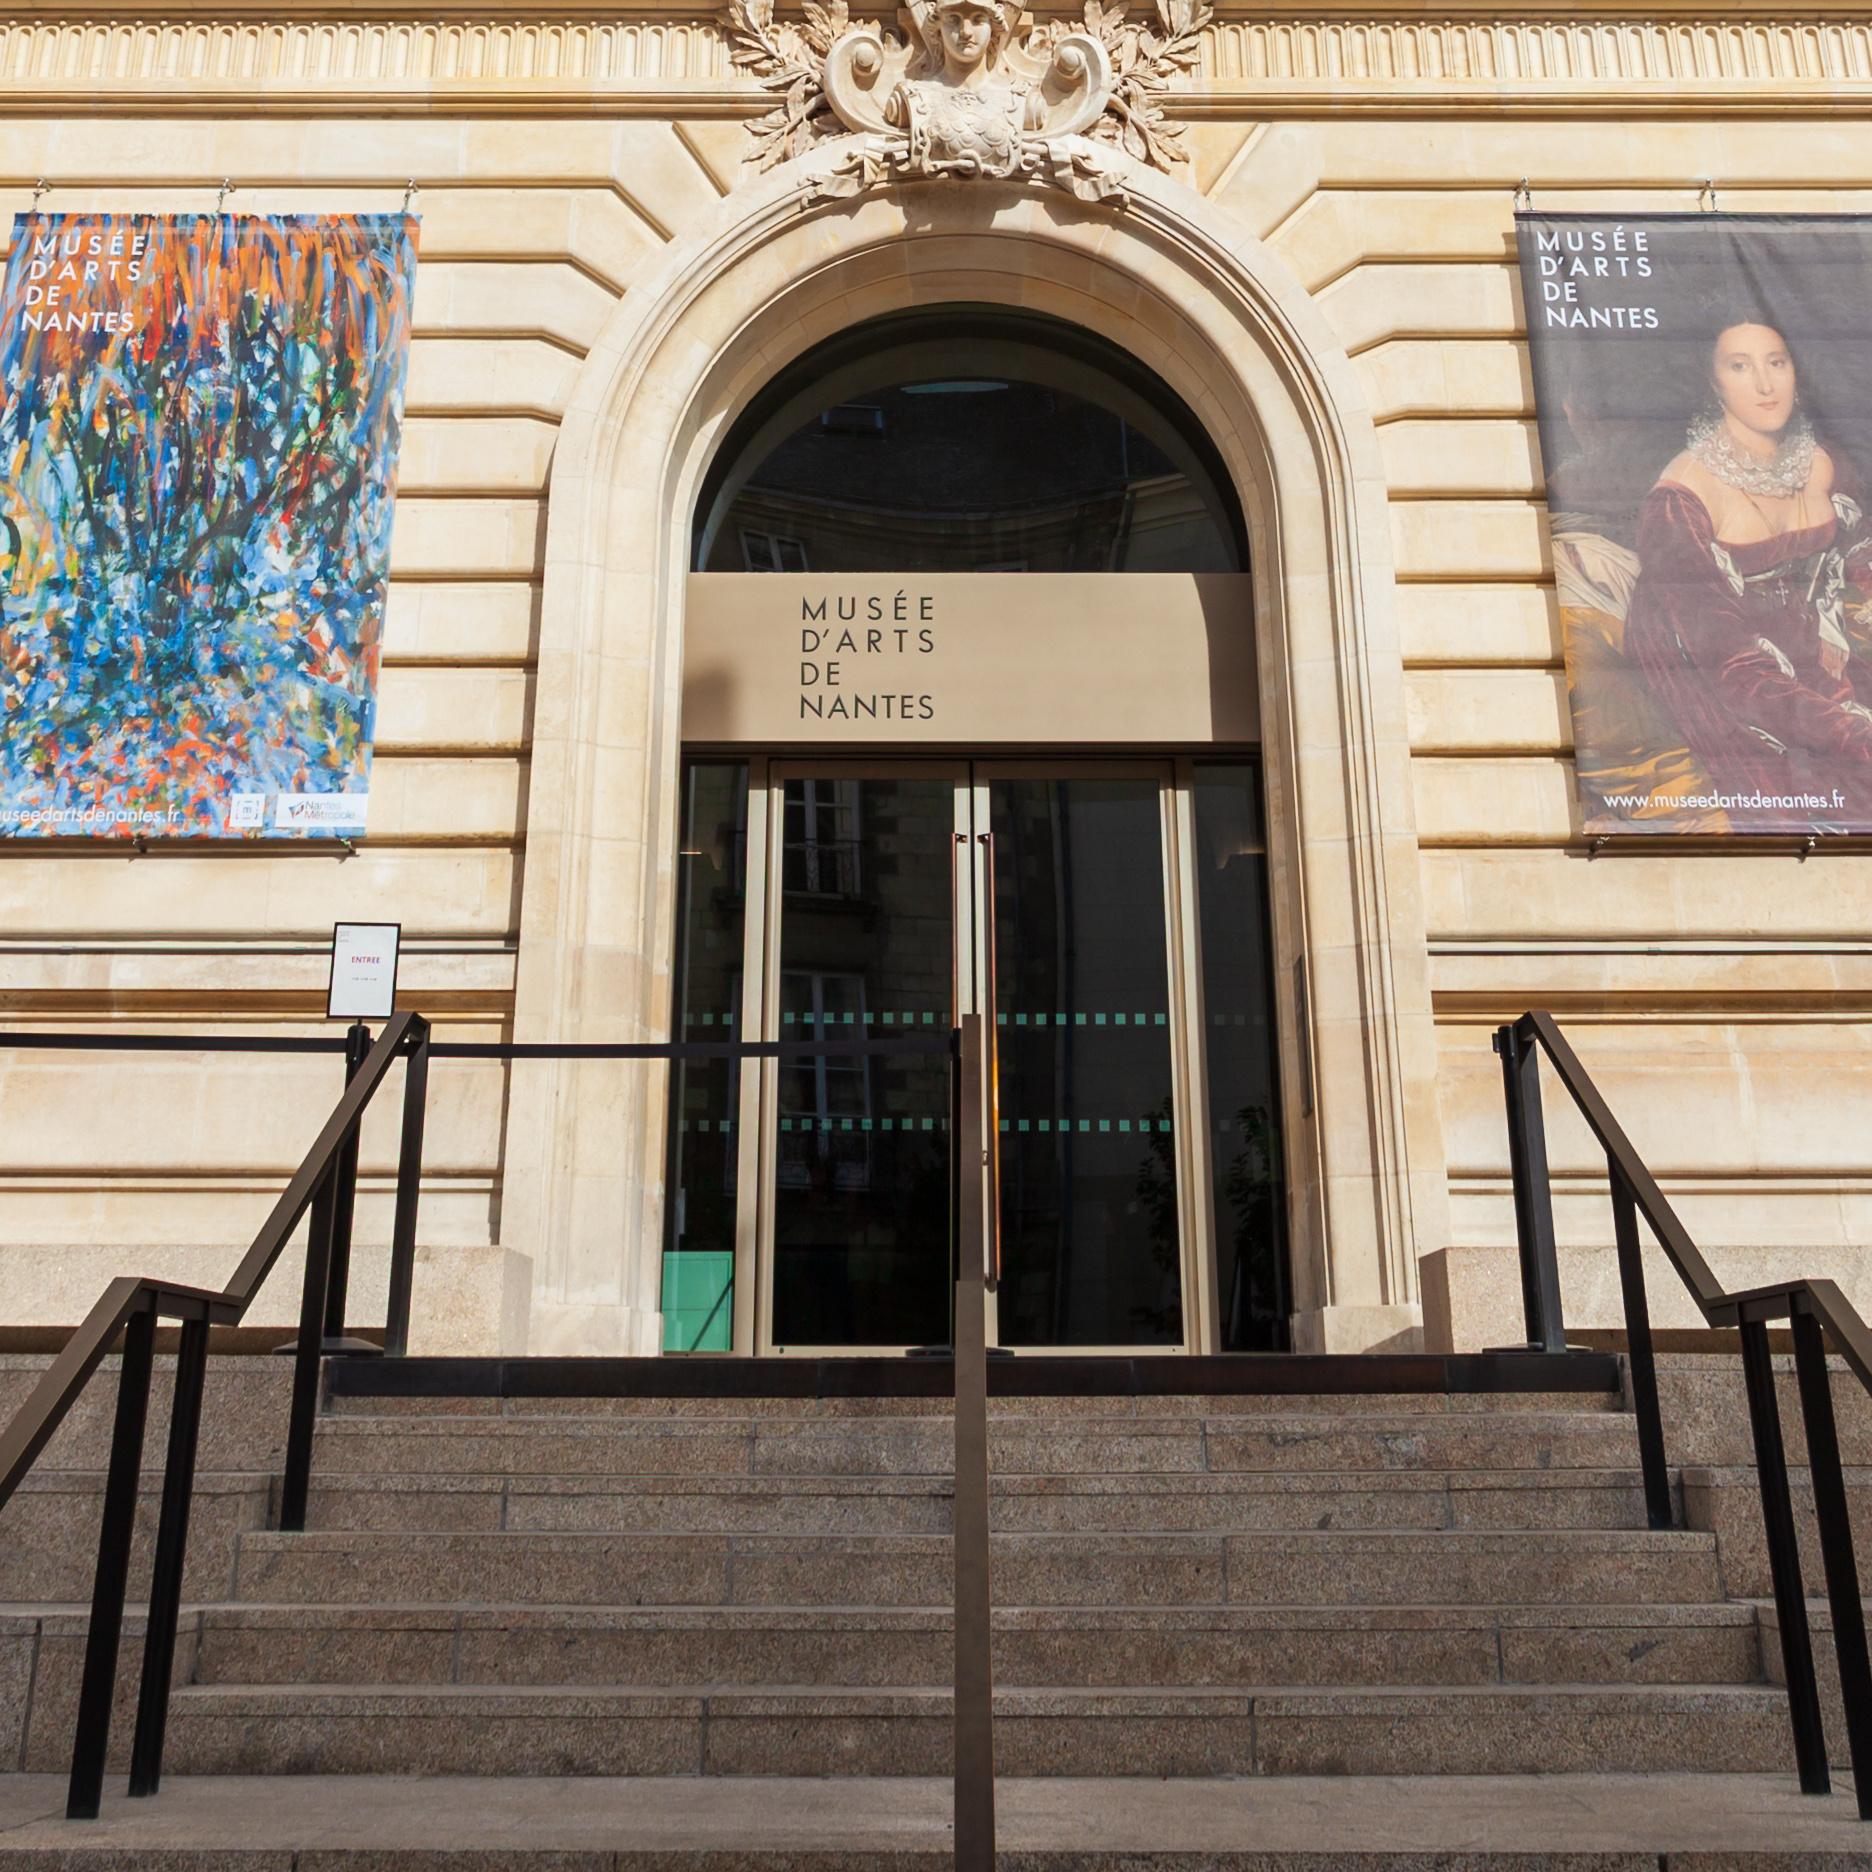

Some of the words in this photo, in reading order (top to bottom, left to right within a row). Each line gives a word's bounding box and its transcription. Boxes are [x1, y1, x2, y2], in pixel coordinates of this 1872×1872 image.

[33, 229, 146, 256] MUSÉE
[1536, 226, 1649, 253] MUSÉE
[29, 260, 142, 282] D'ARTS
[1539, 256, 1653, 277] D'ARTS
[24, 286, 60, 307] DE
[1543, 281, 1578, 303] DE
[20, 312, 134, 333] NANTES
[1546, 307, 1659, 329] NANTES
[801, 589, 935, 622] MUSÉE
[801, 629, 935, 654] D'ARTS
[800, 661, 841, 687] DE
[800, 694, 935, 720] NANTES
[1603, 789, 1846, 811] www.museedartsdenantes.fr
